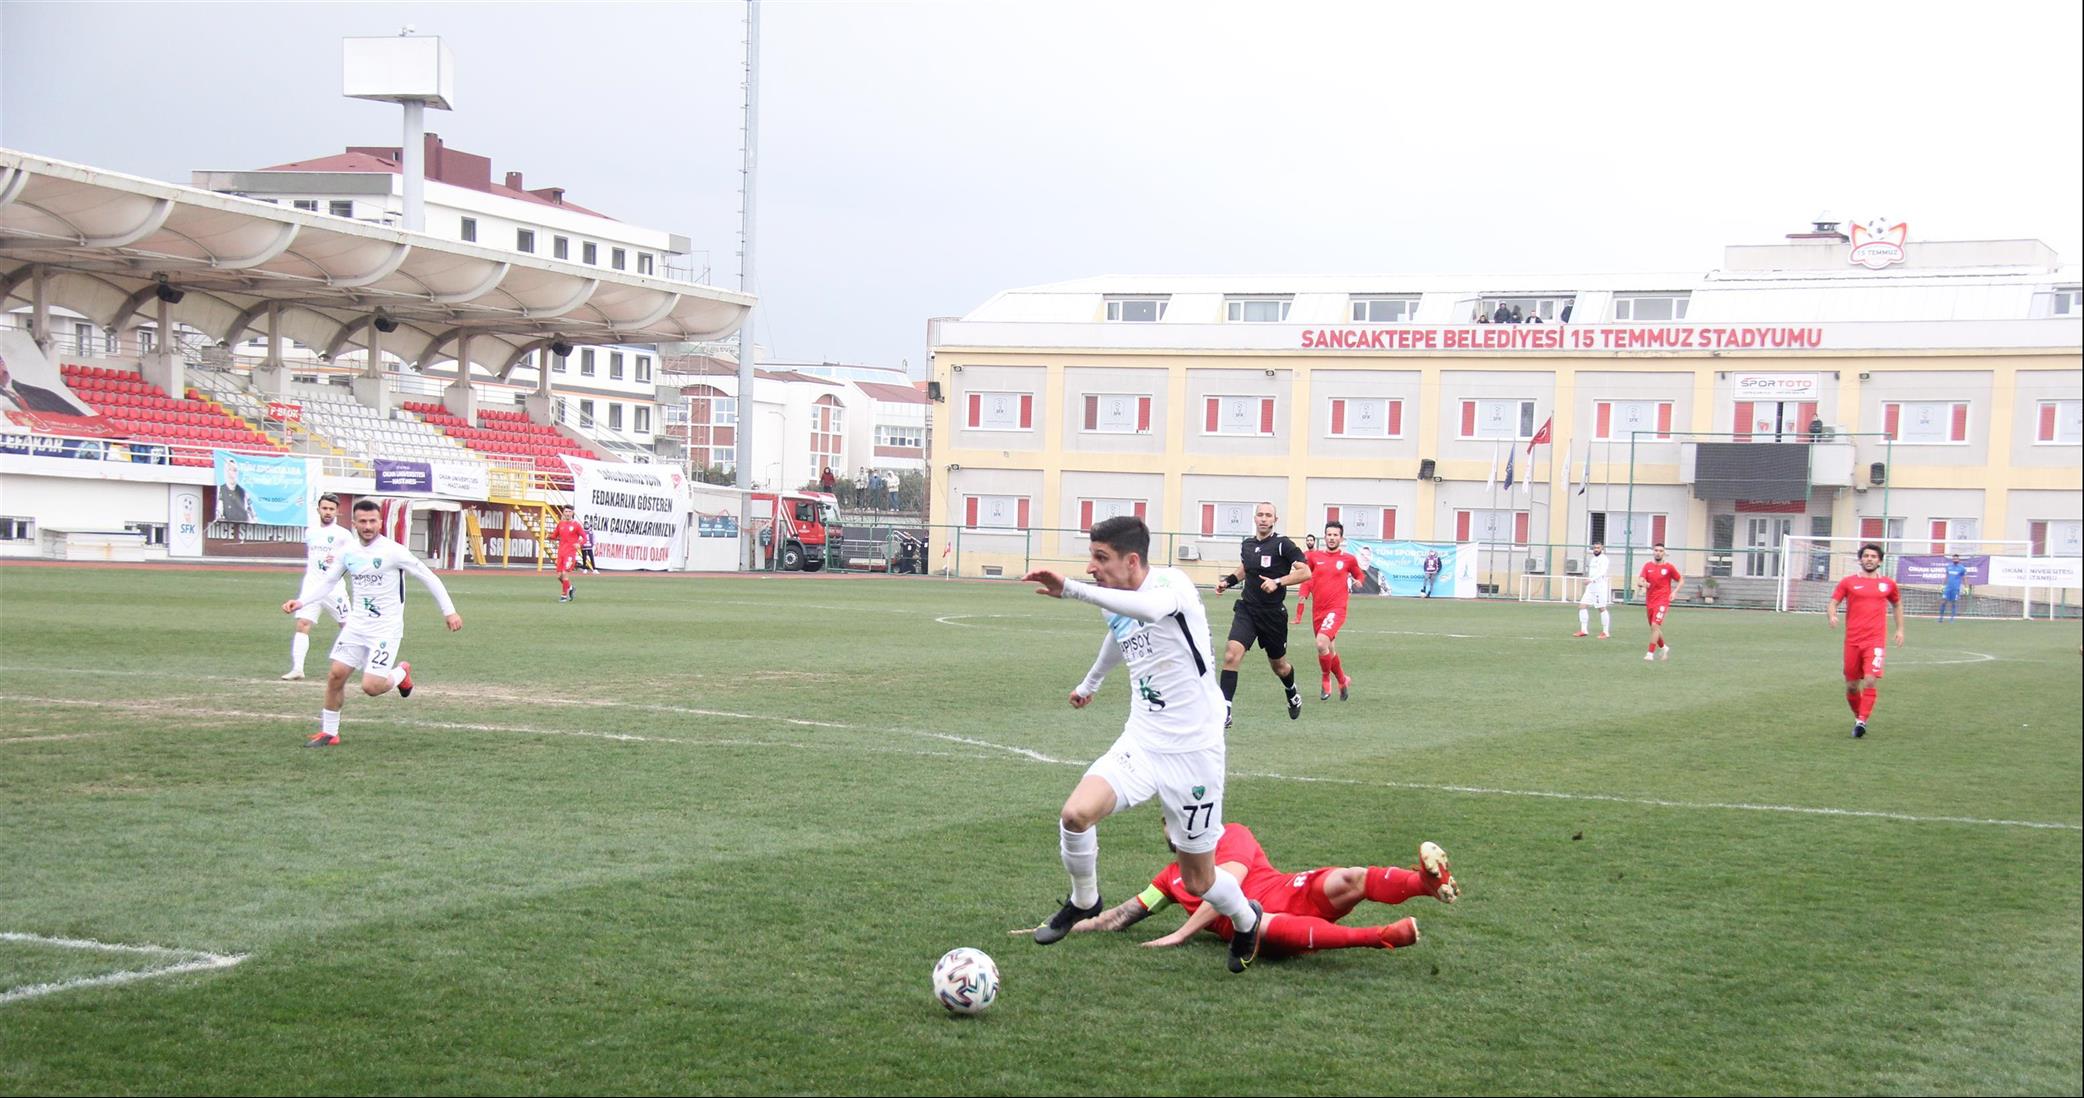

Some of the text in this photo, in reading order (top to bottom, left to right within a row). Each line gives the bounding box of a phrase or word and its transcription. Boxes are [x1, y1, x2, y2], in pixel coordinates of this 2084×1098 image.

[1301, 324, 1822, 348] SANCAKTEPE BELEDİYESİ 15 TEMMUZ STADYUMU
[592, 489, 673, 512] FEDAKARLIK GÖSTEREN
[180, 523, 196, 534] SFK
[625, 545, 649, 561] KUTLU
[336, 604, 349, 616] 14
[371, 649, 390, 667] 22
[1183, 802, 1214, 831] 77
